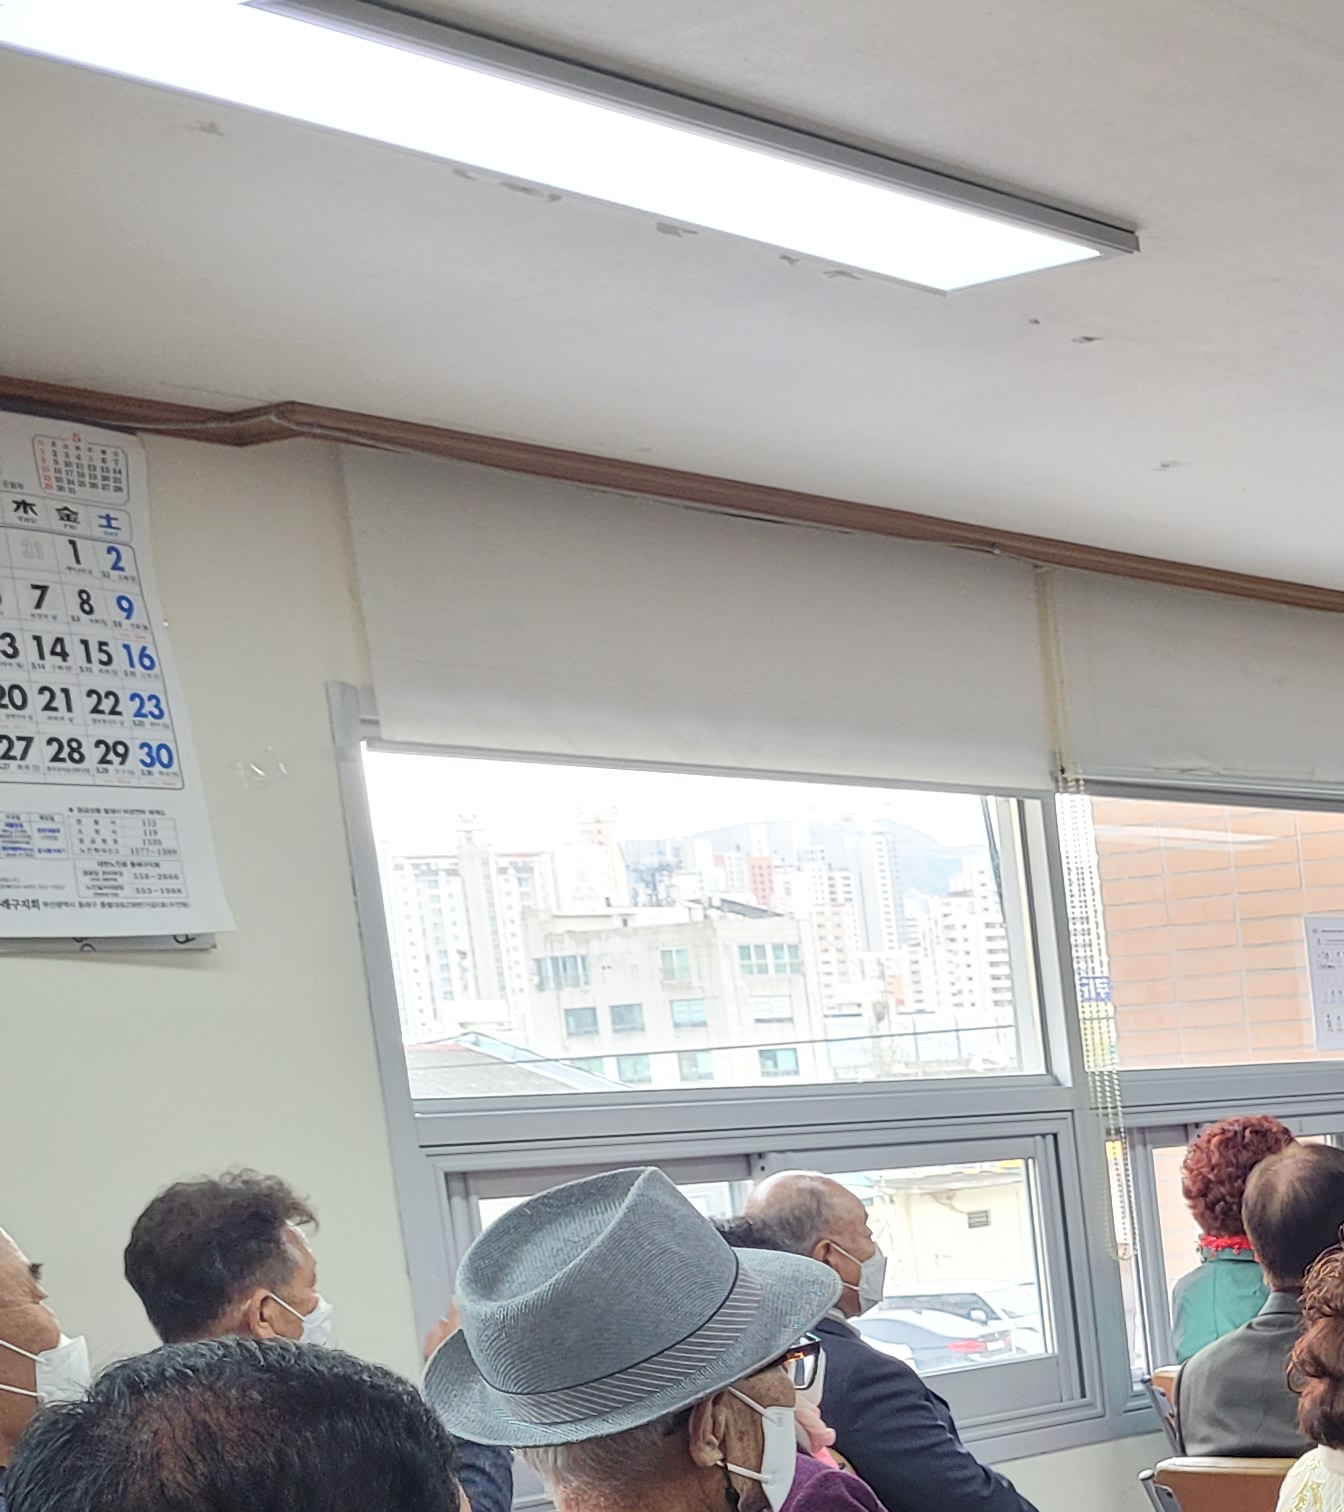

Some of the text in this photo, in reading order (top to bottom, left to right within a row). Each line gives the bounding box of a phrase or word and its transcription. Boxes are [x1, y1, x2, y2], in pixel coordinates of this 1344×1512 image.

[12, 499, 122, 531] 木 金 土
[67, 539, 81, 565] 1
[106, 545, 126, 572] 2
[30, 583, 135, 620] 7 8 9
[32, 634, 70, 663] 14
[80, 638, 113, 667] 15
[122, 643, 156, 671] 16
[38, 685, 73, 713] 21
[86, 689, 124, 717] 22
[129, 692, 165, 720] 23
[0, 734, 174, 769] 27 28 29 30
